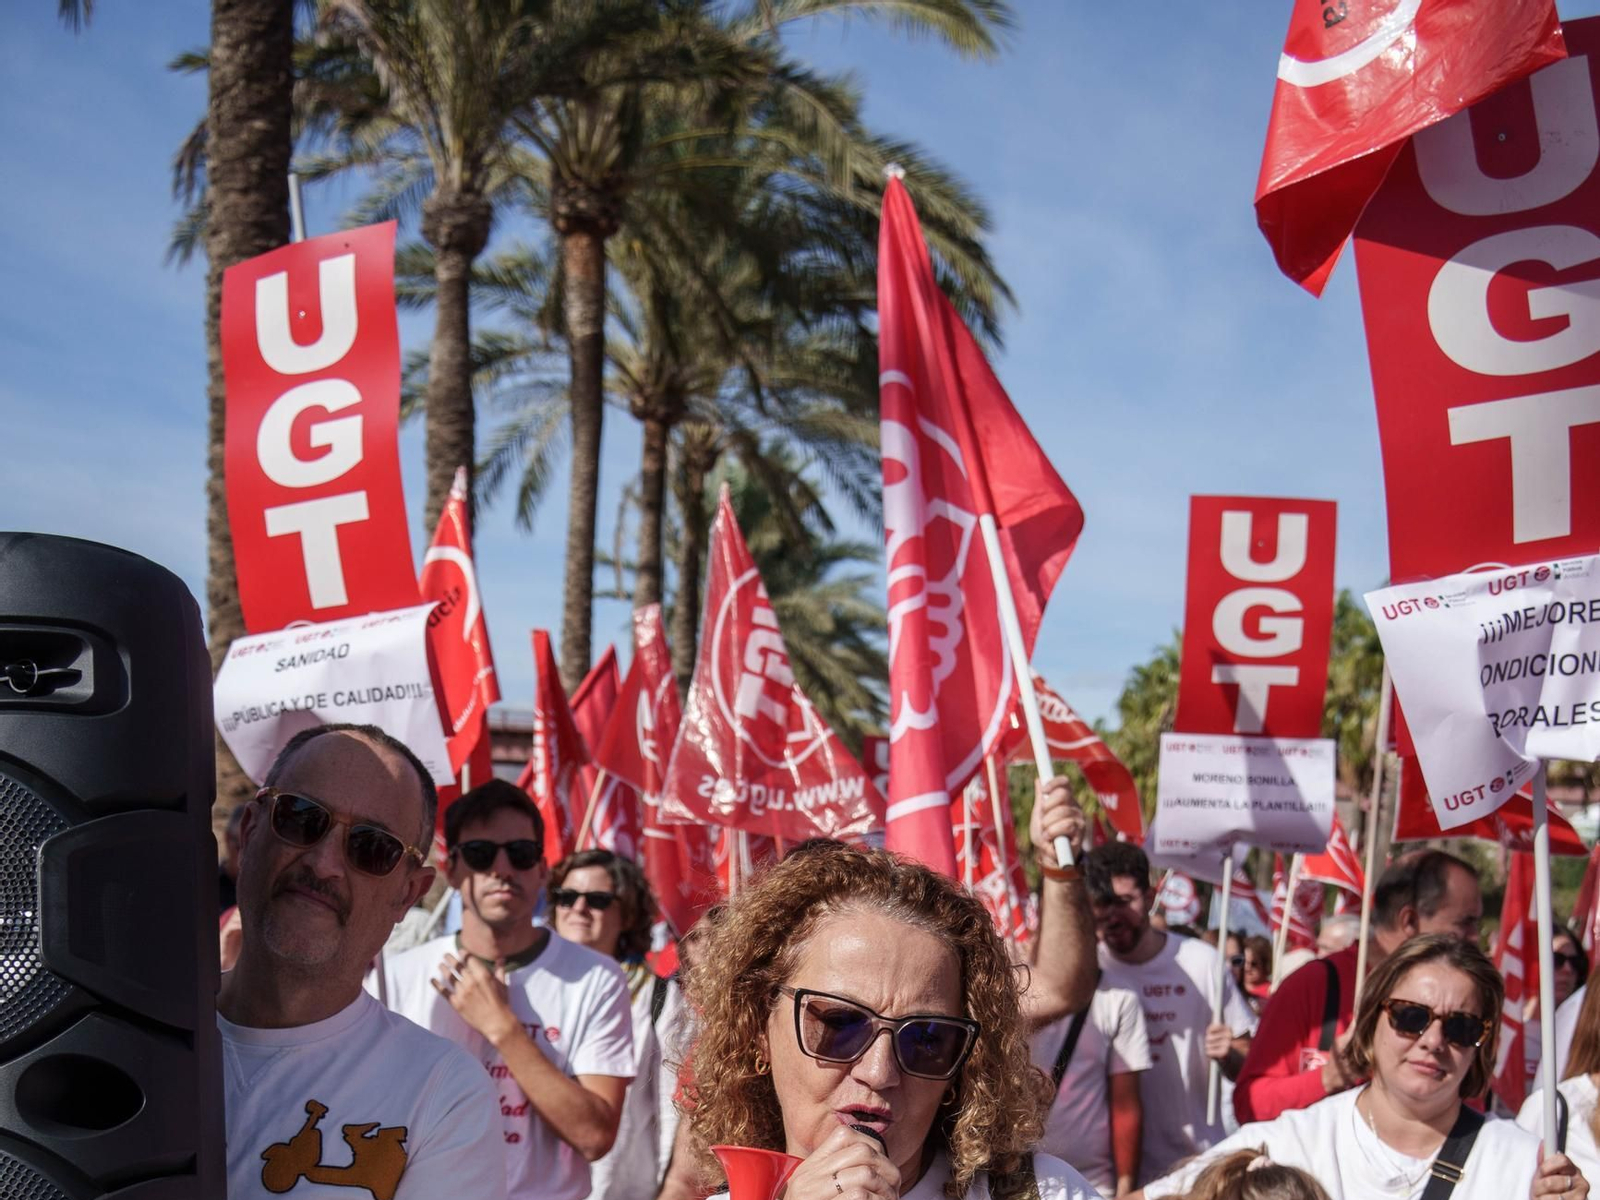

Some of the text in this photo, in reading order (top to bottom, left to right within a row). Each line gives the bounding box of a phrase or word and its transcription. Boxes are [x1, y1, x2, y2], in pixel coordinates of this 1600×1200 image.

[1412, 55, 1600, 545] UGT
[256, 253, 370, 610] UGT
[1488, 571, 1530, 596] UGT
[1212, 510, 1309, 733] UGT
[1382, 598, 1422, 621] UGT
[274, 643, 350, 673] SANIDAD
[1480, 651, 1600, 688] ONDICION
[305, 693, 327, 710] DE
[1444, 785, 1486, 811] UGT
